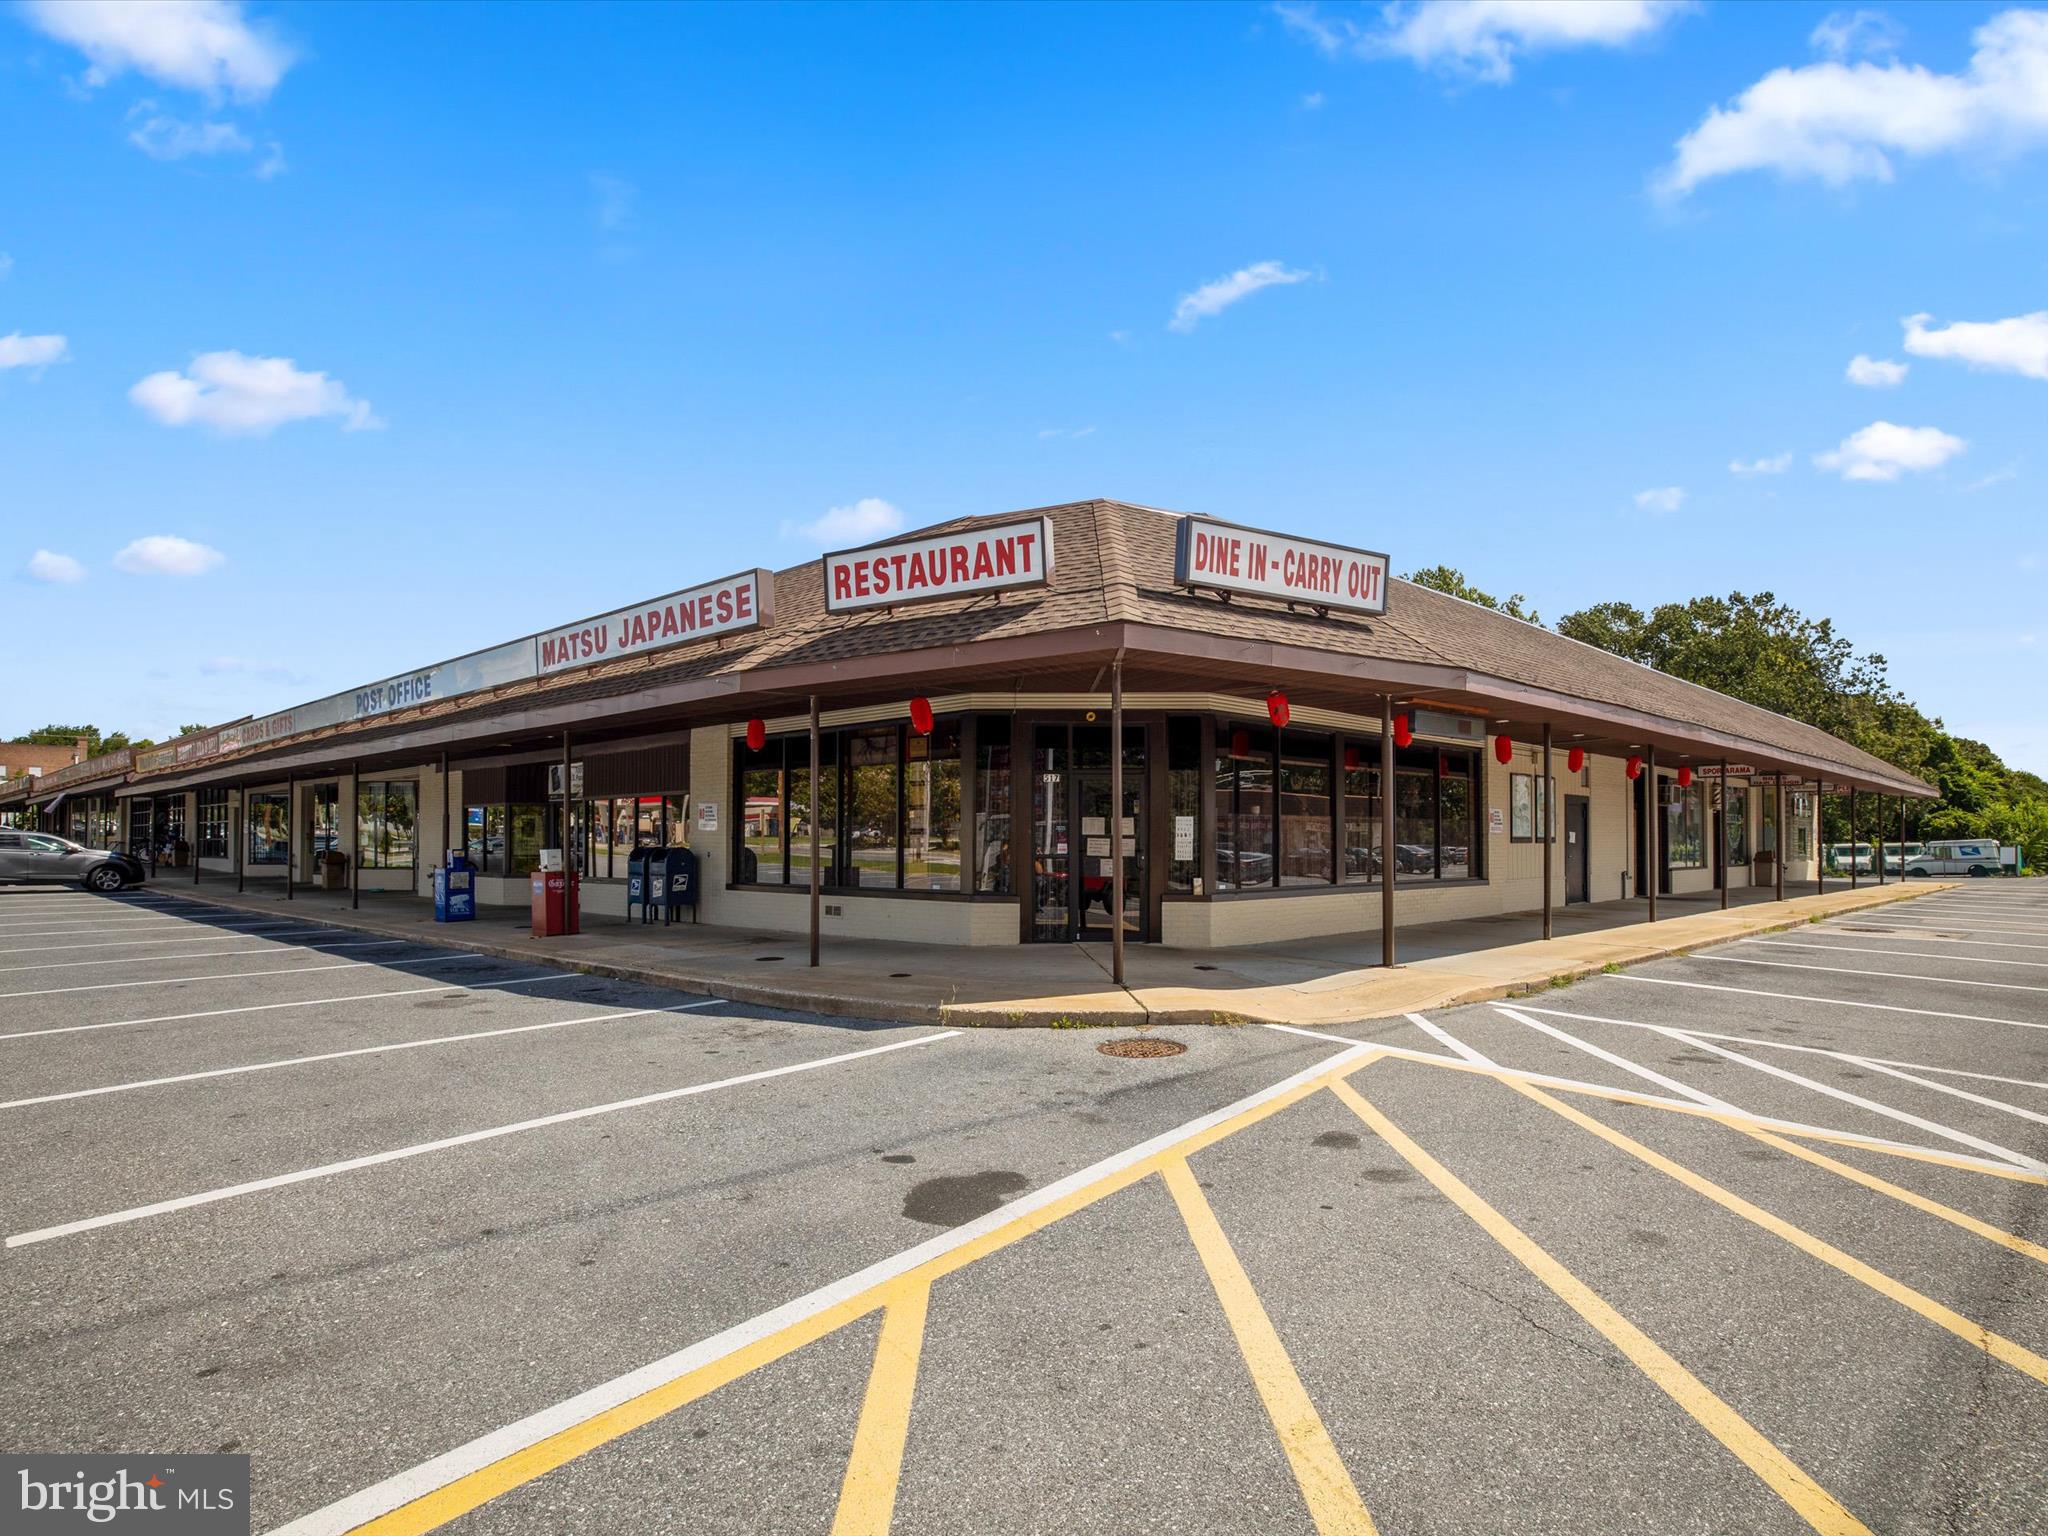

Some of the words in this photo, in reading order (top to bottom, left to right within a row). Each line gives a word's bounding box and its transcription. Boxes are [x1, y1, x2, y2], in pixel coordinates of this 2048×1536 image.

[834, 533, 1035, 600] RESTAURANT
[1195, 532, 1241, 577] DINE
[1348, 561, 1381, 601] OUT
[542, 624, 608, 667] MATSU
[618, 584, 752, 648] JAPANESE
[356, 687, 384, 713] POST
[388, 674, 432, 706] OFFICE
[241, 722, 263, 743] CARDS
[272, 714, 293, 735] GIFTS
[1043, 774, 1060, 782] 517
[1702, 766, 1750, 775] SPORARAMA
